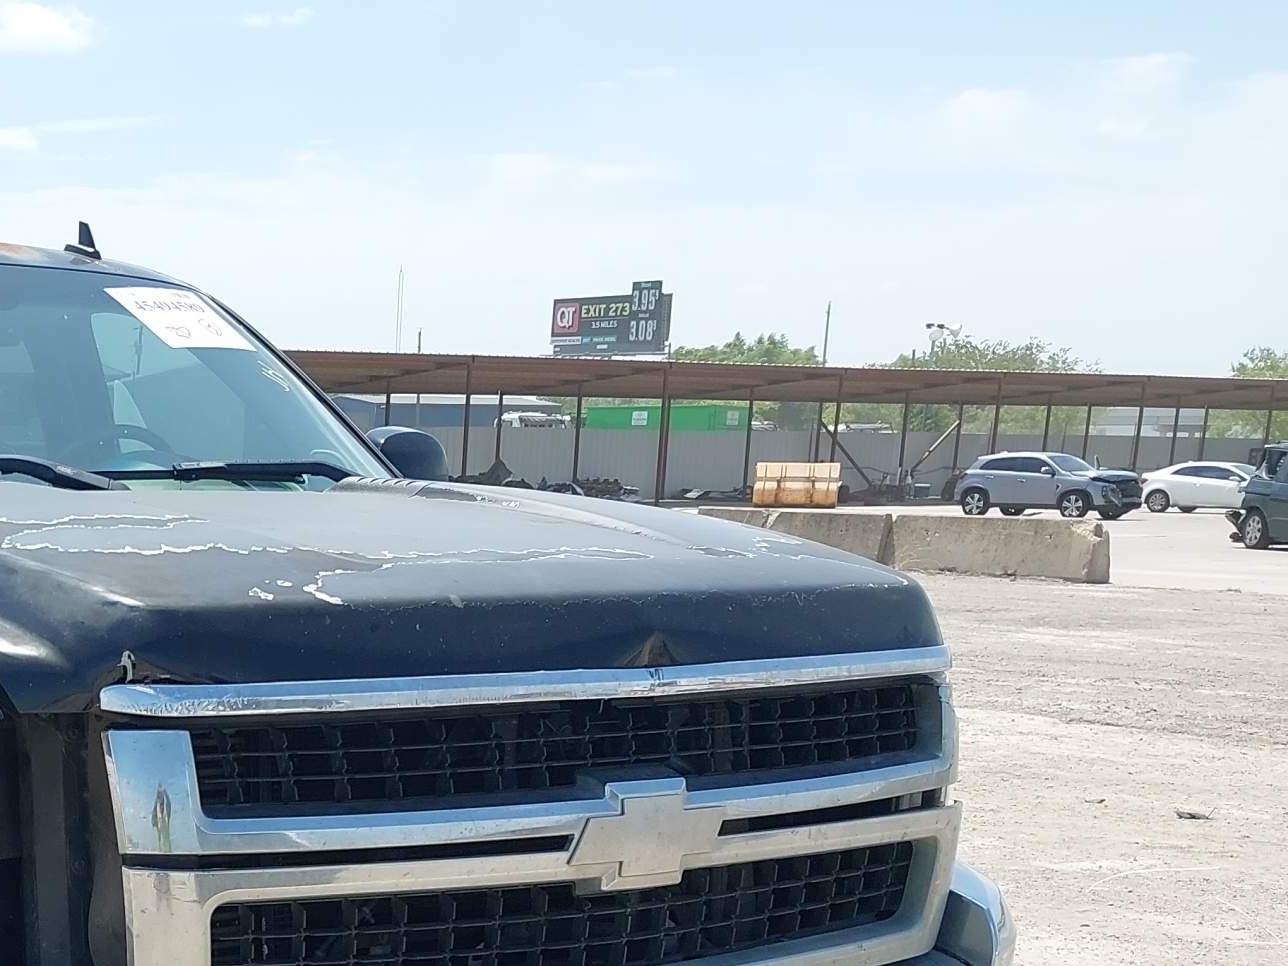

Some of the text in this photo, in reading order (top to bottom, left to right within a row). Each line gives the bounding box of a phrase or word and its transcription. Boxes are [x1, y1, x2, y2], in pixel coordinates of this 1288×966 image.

[557, 307, 576, 329] QT
[581, 303, 630, 318] EXIT 273
